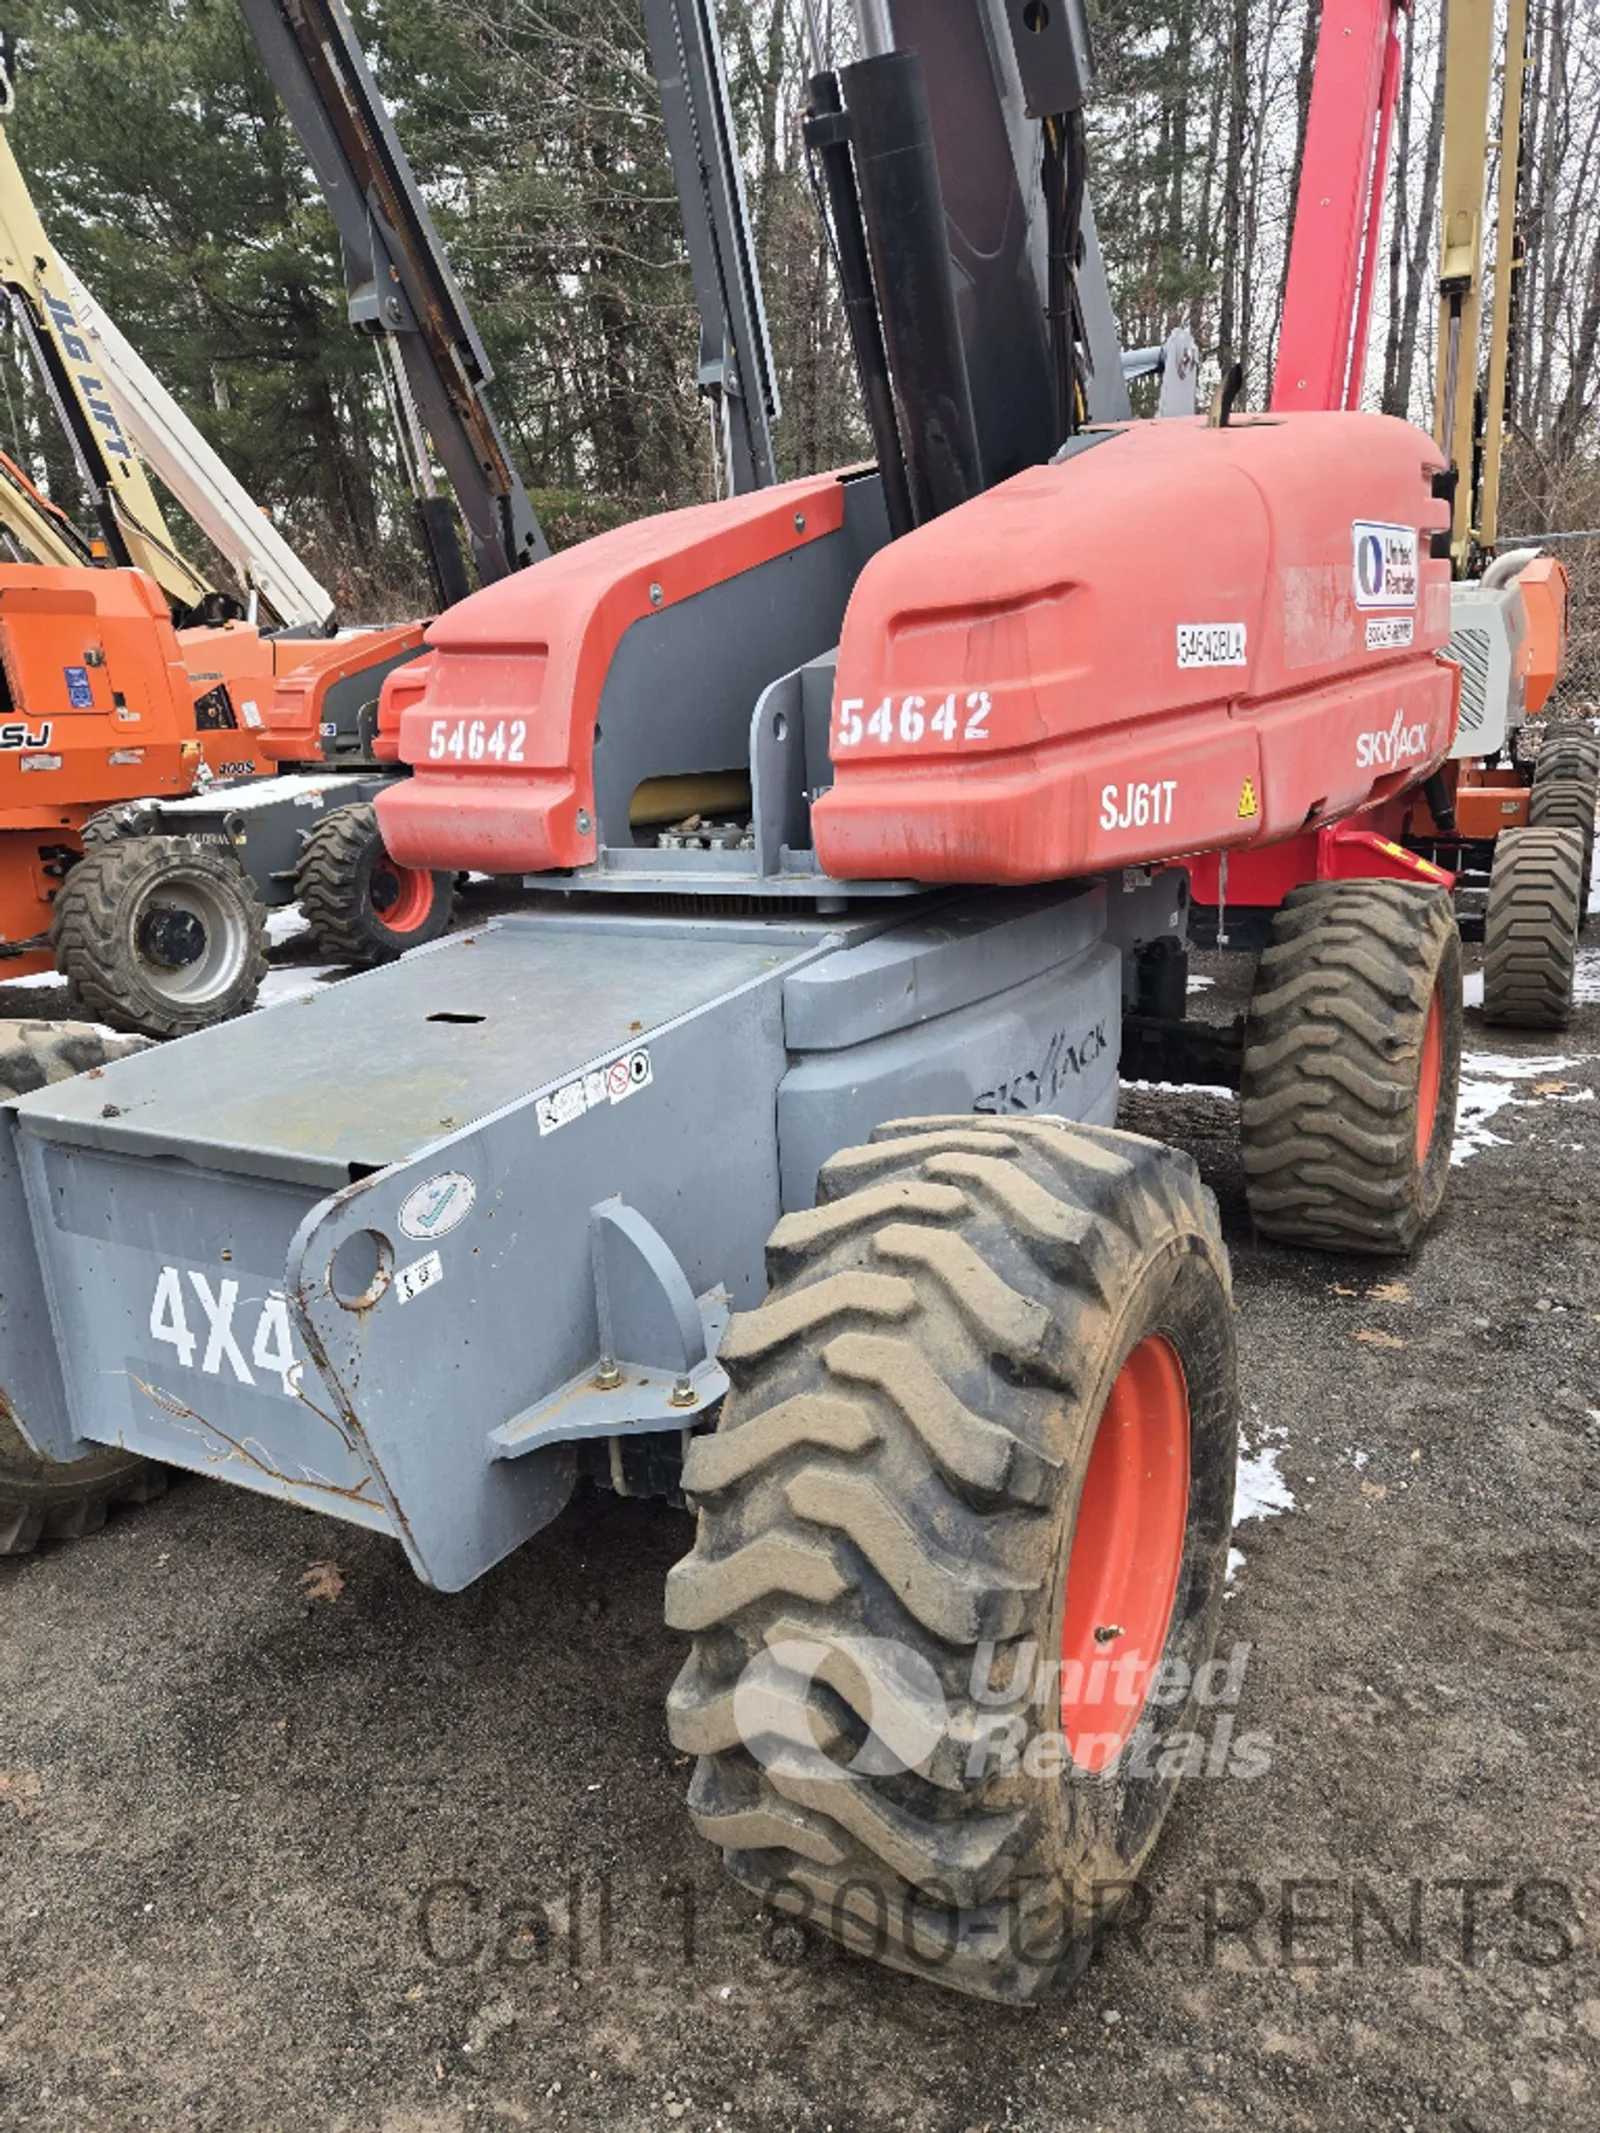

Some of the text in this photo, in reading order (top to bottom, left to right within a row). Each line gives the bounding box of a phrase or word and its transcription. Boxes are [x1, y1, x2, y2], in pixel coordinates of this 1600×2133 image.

[41, 287, 132, 459] JLG LIFT
[429, 719, 526, 761] 54642
[838, 692, 992, 747] 54642
[1356, 708, 1428, 769] SKYJACK
[1100, 781, 1177, 830] SJ61T
[973, 1018, 1107, 1114] SKYJACK
[150, 1266, 303, 1396] 4X4
